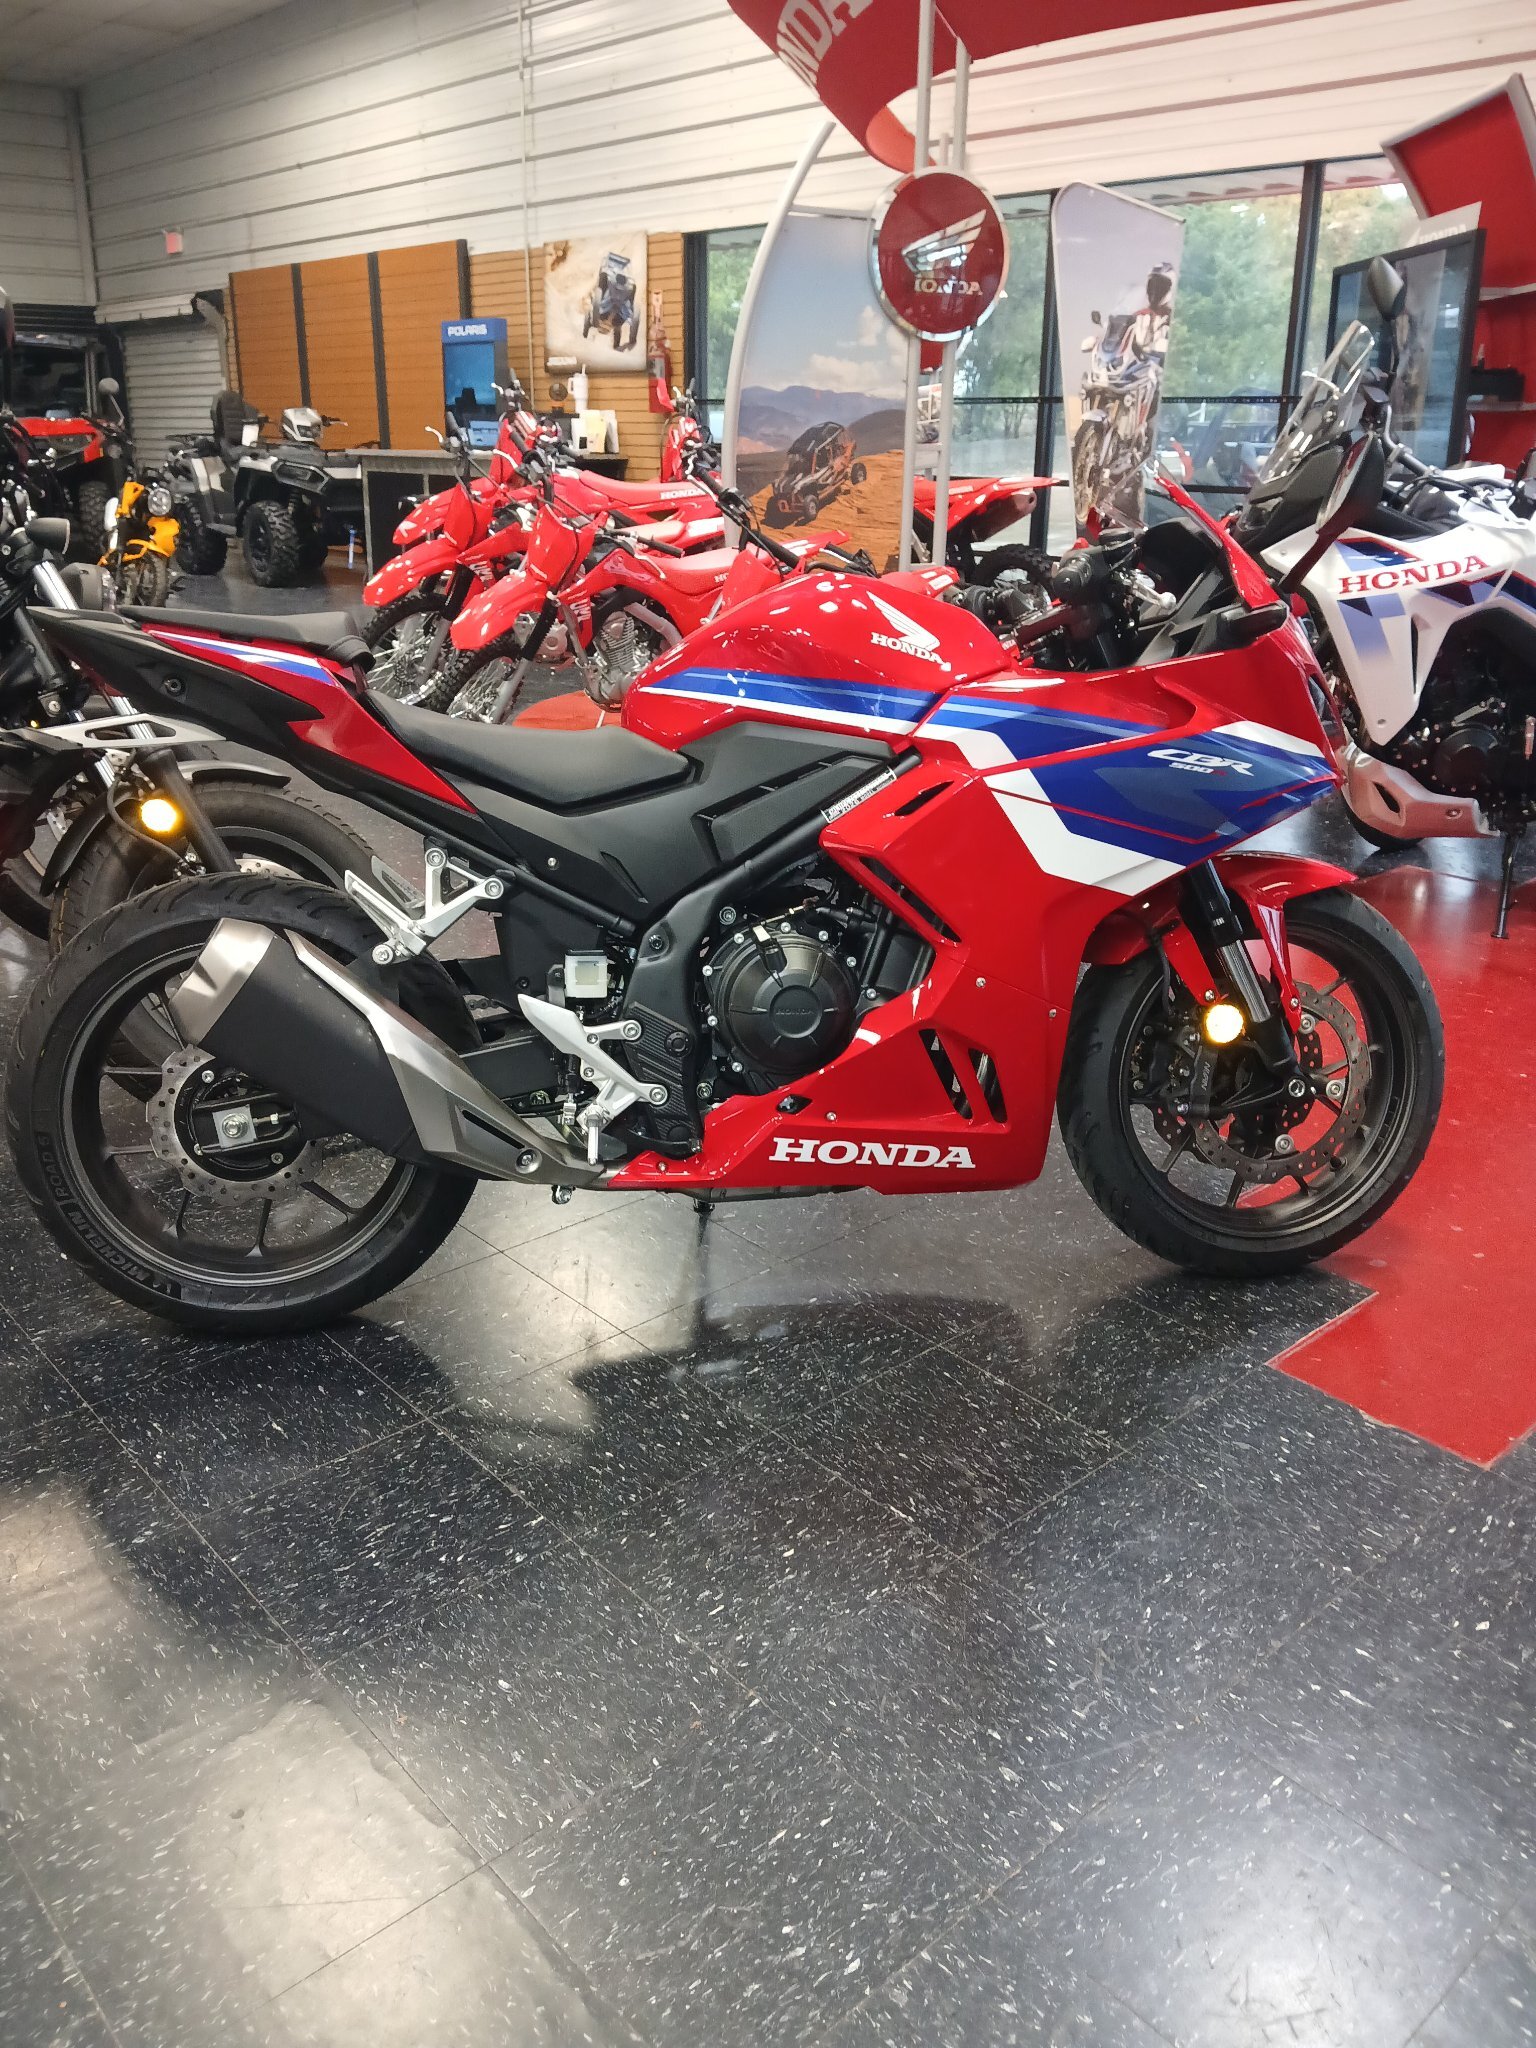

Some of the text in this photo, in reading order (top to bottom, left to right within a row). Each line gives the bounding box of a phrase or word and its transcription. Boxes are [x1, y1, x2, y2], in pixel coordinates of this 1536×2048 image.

[447, 324, 487, 337] POLARIS
[1339, 555, 1490, 594] HONDA
[871, 631, 944, 664] HONDA
[1147, 749, 1254, 777] CBR
[769, 1137, 976, 1169] HONDA
[68, 1210, 150, 1281] MICHELIN
